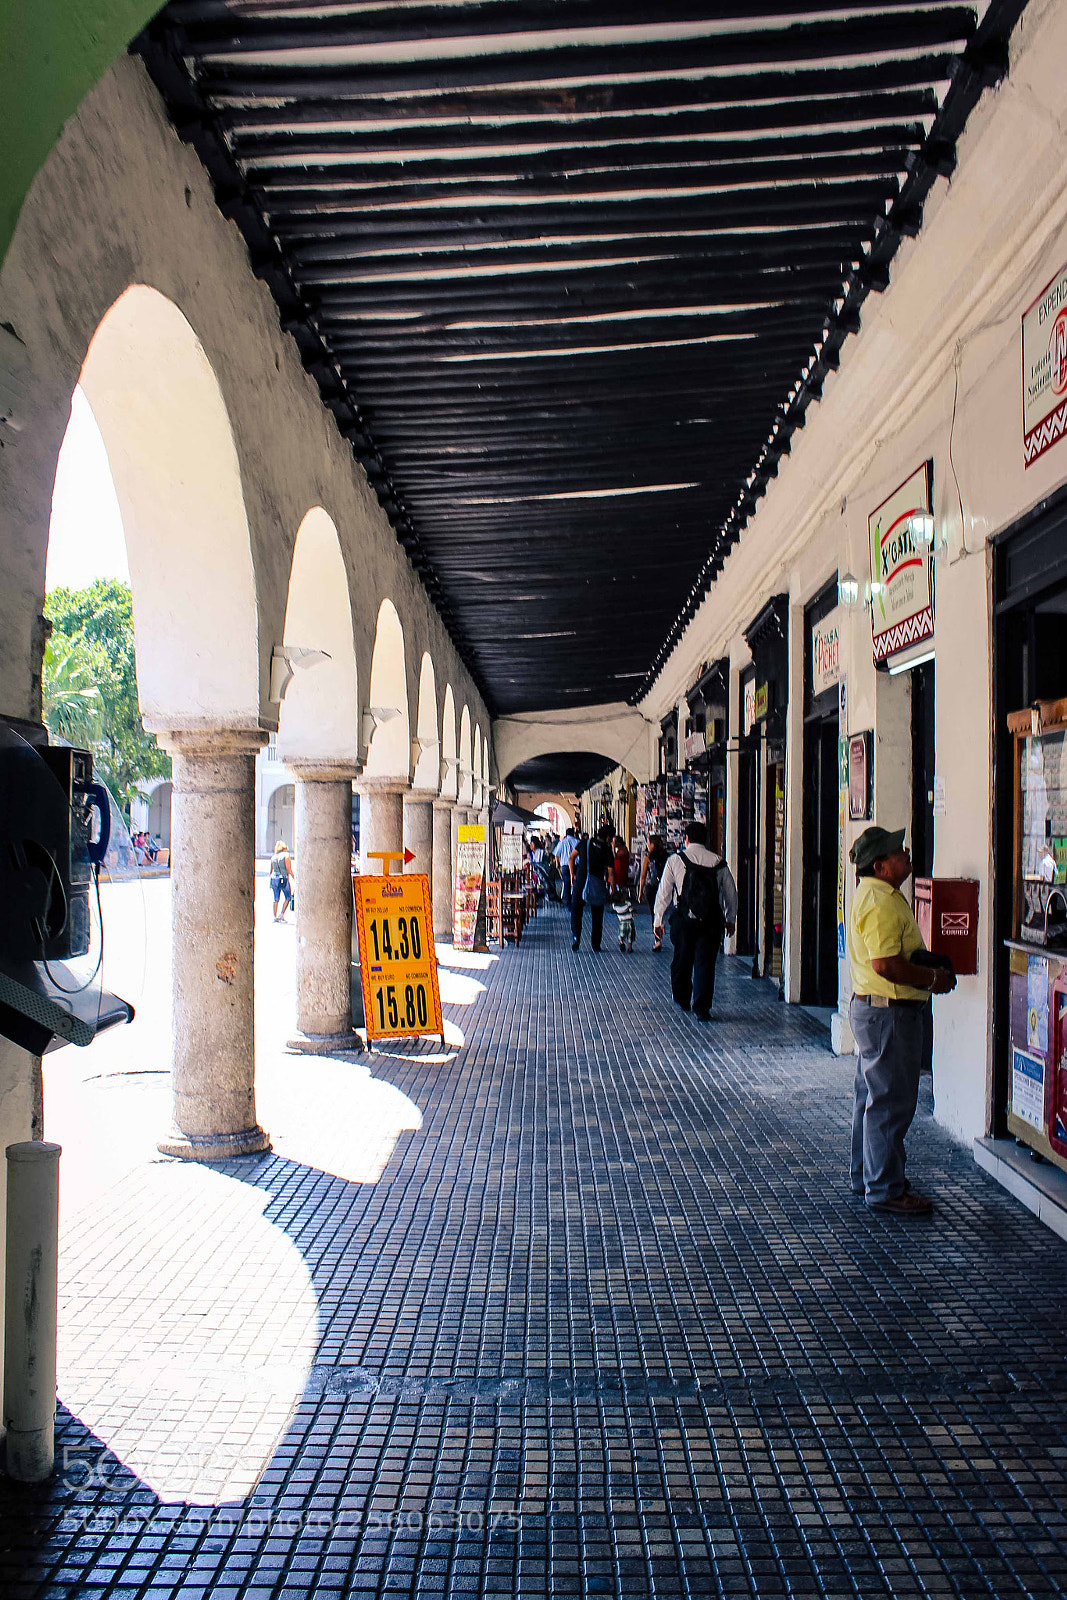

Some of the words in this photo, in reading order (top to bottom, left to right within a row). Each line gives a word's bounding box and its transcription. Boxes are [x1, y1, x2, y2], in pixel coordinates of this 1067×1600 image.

[370, 916, 421, 961] 14.30
[941, 928, 969, 936] CORREO
[376, 984, 428, 1029] 15.80
